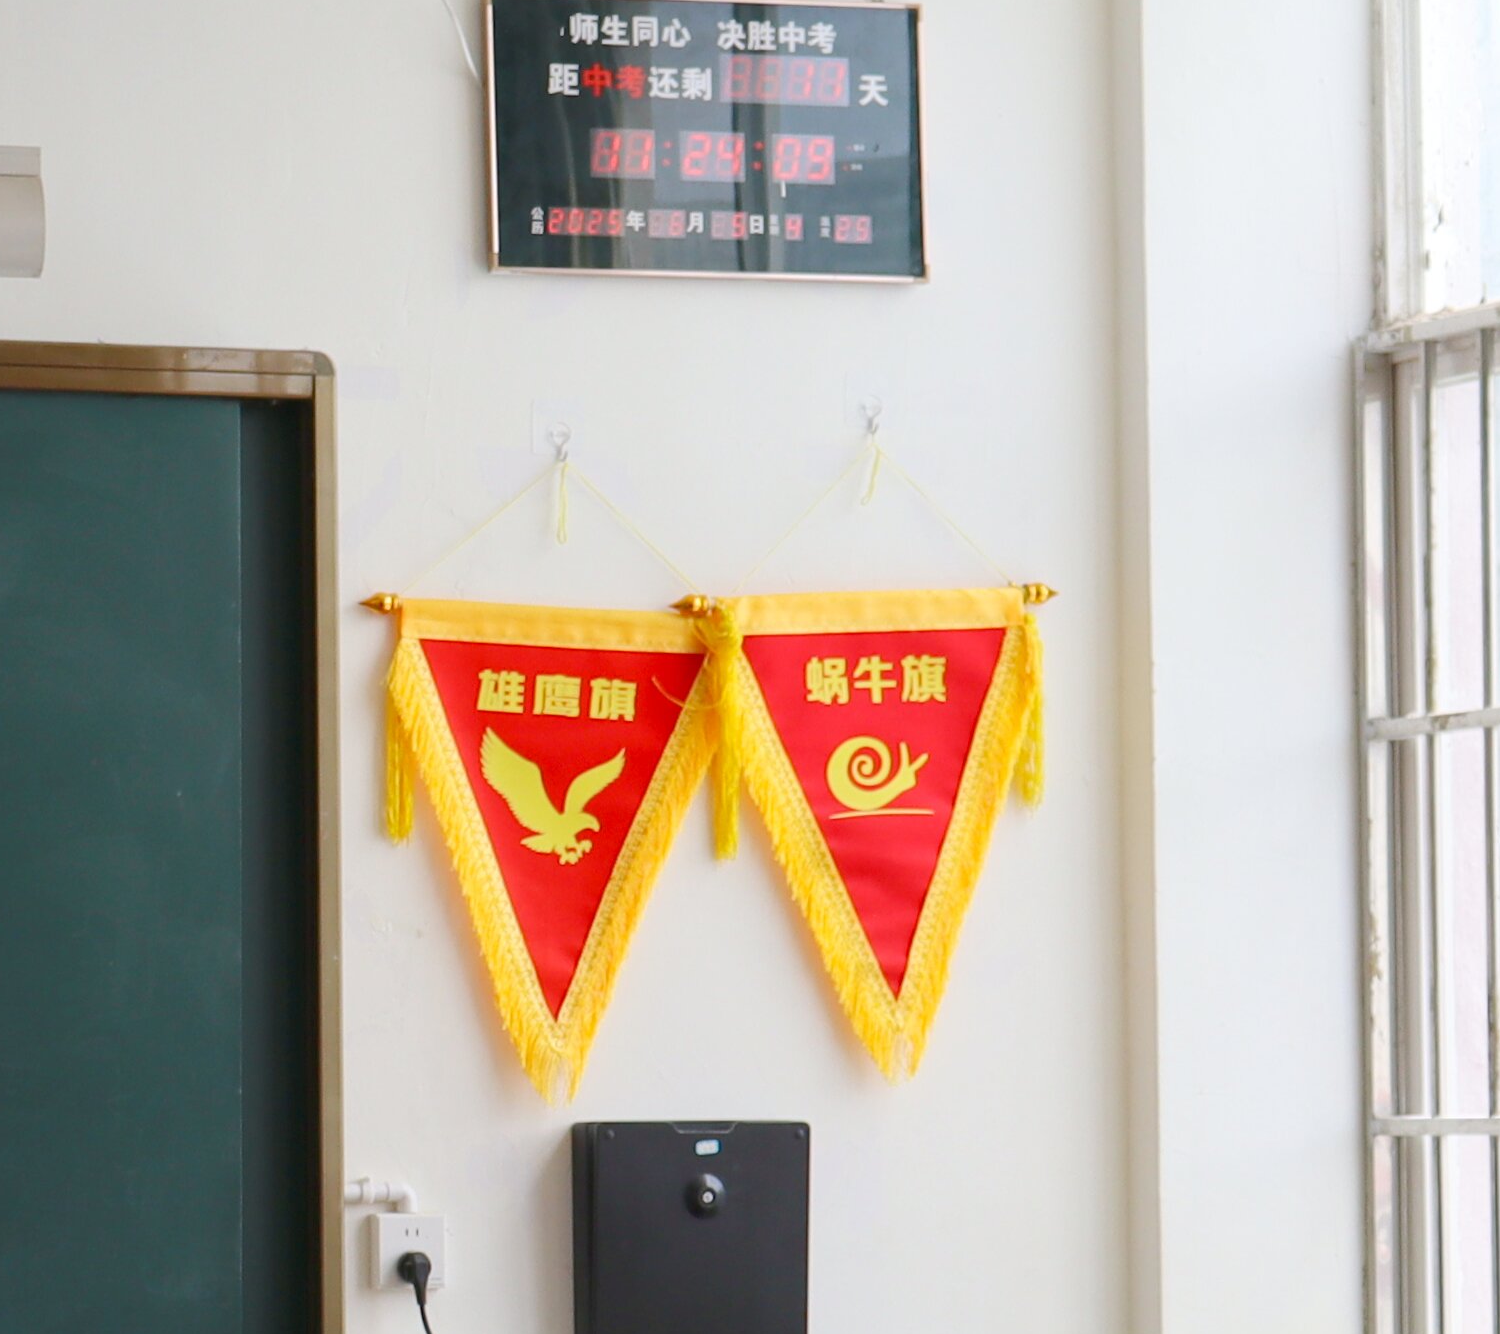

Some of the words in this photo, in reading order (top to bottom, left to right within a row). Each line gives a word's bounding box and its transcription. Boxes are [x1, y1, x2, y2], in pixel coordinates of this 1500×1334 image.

[569, 13, 692, 49] 师生同心
[716, 21, 837, 55] 决胜中考
[548, 62, 712, 102] 距中考还剩
[858, 75, 888, 106] 天
[476, 668, 638, 722] 雄鹰旗
[805, 655, 947, 705] 蜗牛旗
